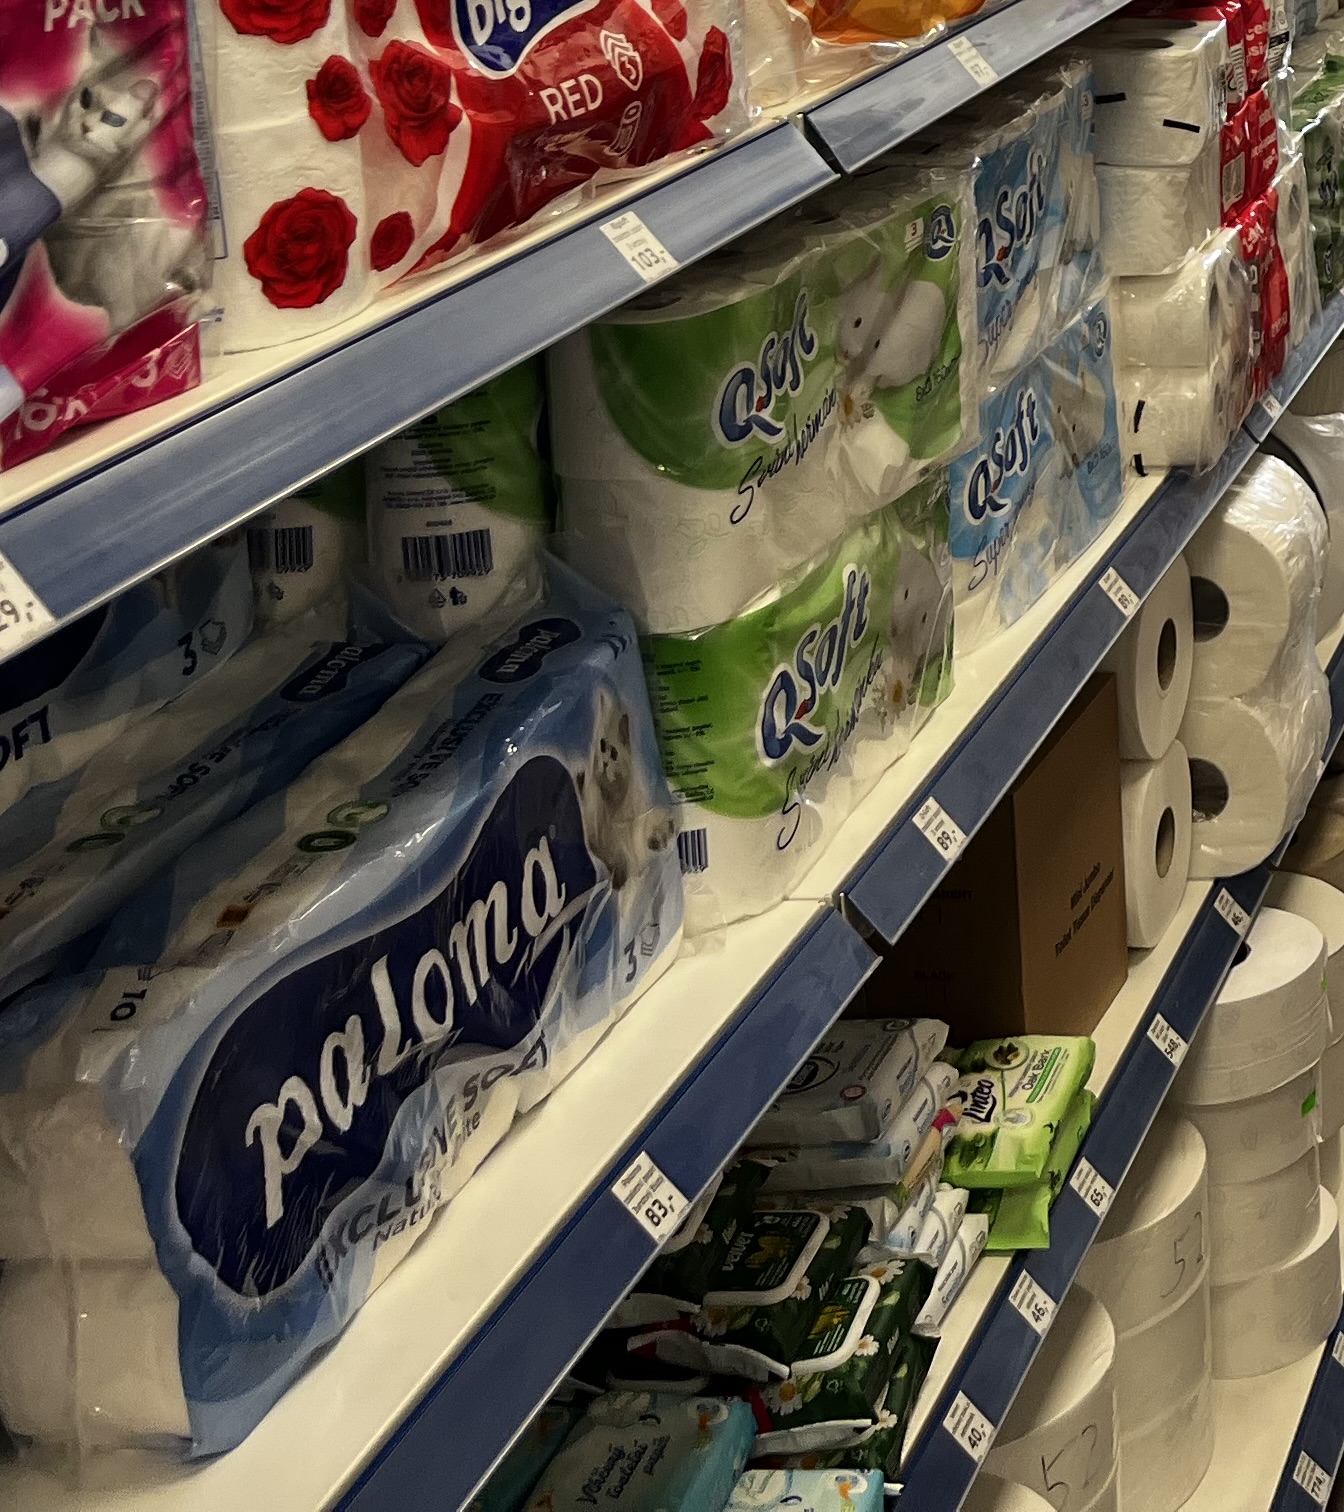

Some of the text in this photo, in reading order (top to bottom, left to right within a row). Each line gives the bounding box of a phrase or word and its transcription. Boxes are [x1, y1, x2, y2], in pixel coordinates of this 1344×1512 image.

[540, 72, 606, 127] RED
[631, 246, 667, 273] 103,-
[246, 835, 567, 1229] paloma
[462, 1031, 549, 1112] SOFT
[961, 1078, 998, 1124] Linteo
[643, 1193, 677, 1229] 83,-
[965, 1421, 990, 1451] 40,-
